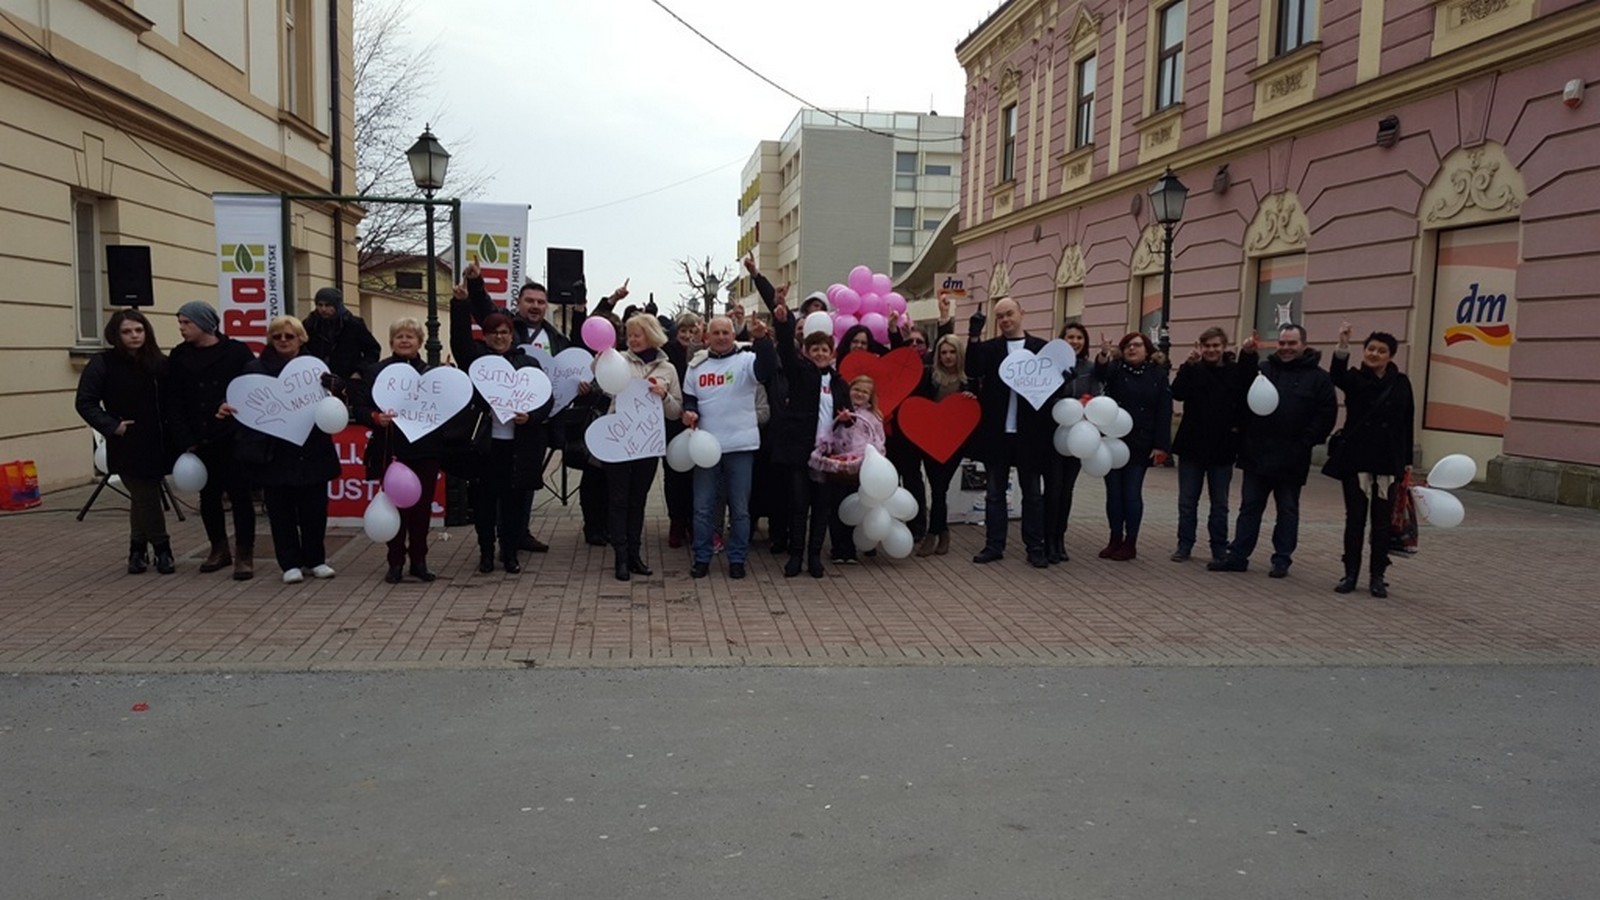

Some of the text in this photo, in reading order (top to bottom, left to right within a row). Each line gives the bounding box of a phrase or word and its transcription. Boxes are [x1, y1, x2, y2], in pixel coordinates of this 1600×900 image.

[268, 244, 278, 291] HRVATSKE
[511, 236, 522, 282] HRVATSKE
[943, 276, 963, 290] dm
[1456, 283, 1507, 324] dm
[283, 366, 322, 394] STOP
[1005, 357, 1053, 380] STOP
[387, 377, 442, 394] RUKE
[510, 389, 538, 403] NIJE
[290, 390, 326, 411] NASILJ
[420, 401, 438, 412] ZA
[487, 395, 531, 411] ZLATO
[605, 397, 646, 443] VOLI A
[327, 478, 380, 501] UST
